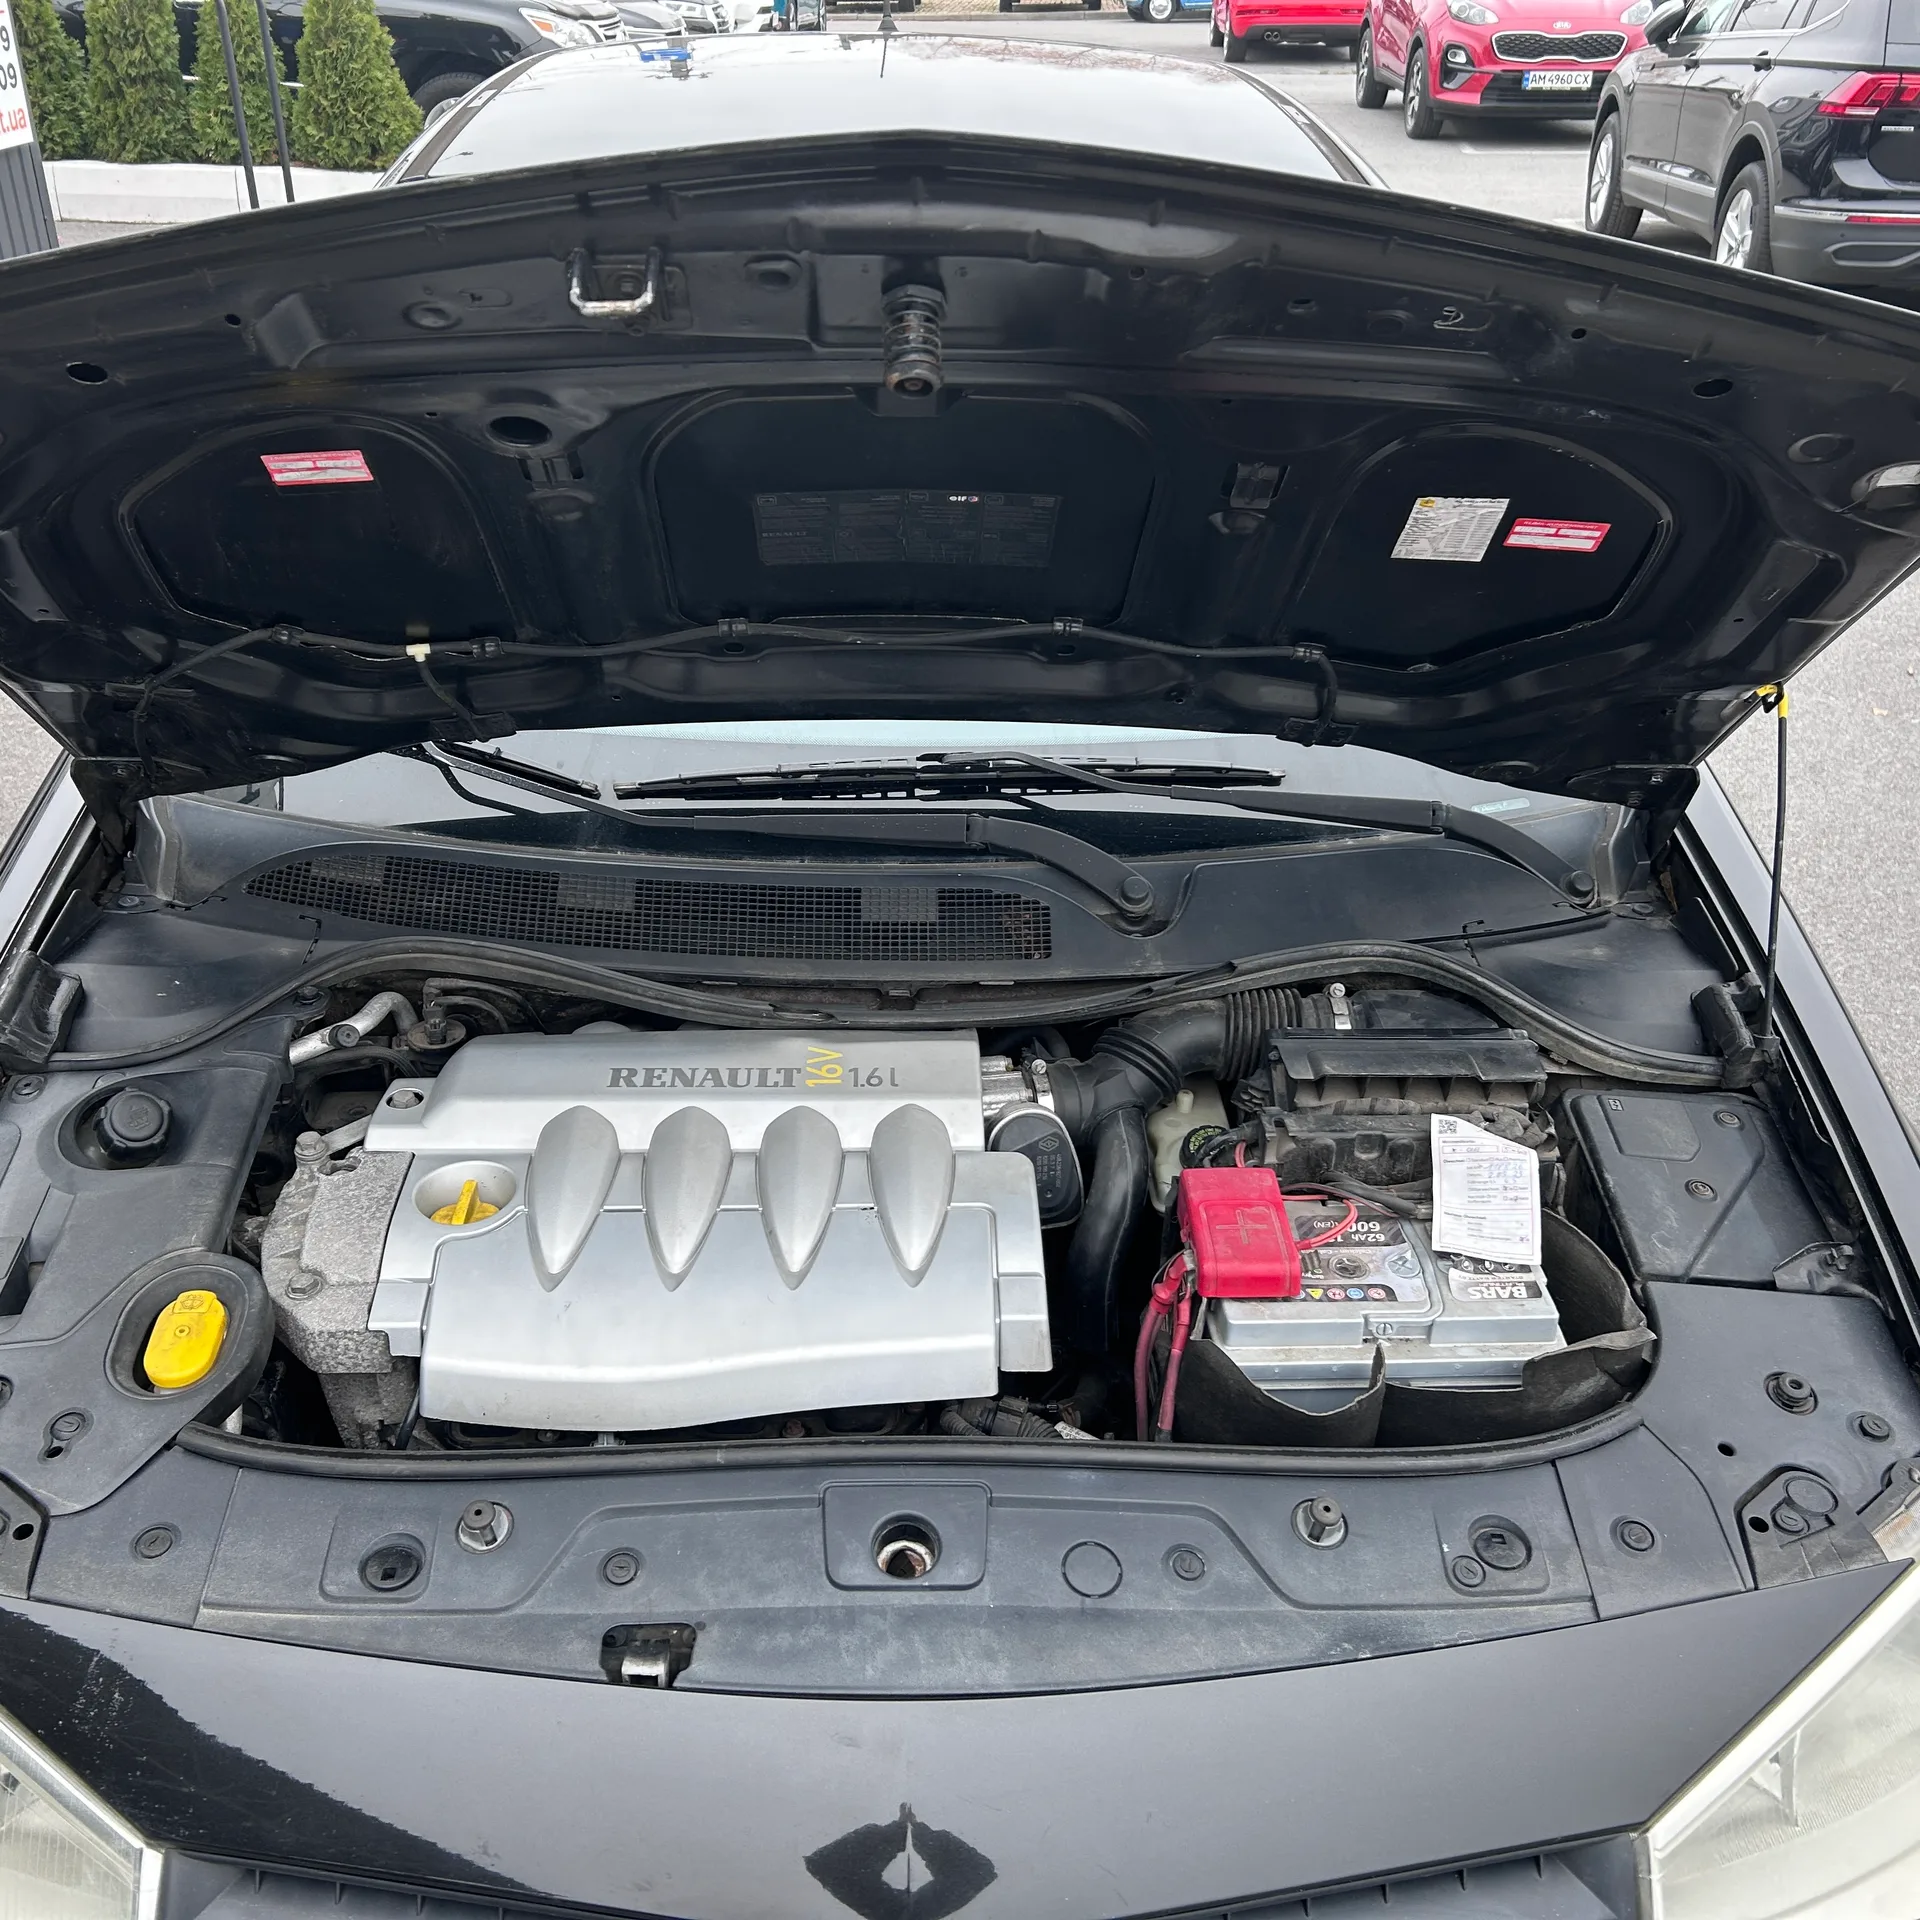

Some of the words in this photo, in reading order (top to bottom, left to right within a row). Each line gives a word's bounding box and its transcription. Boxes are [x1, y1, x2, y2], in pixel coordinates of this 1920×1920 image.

[1530, 73, 1547, 85] AM
[1548, 73, 1573, 85] 4960
[1575, 73, 1590, 85] CX
[606, 1067, 803, 1088] RENAULT
[804, 1046, 843, 1087] 16V
[848, 1067, 883, 1088] 1.6
[1351, 1233, 1385, 1242] 62Ah
[1467, 1286, 1529, 1299] BARS
